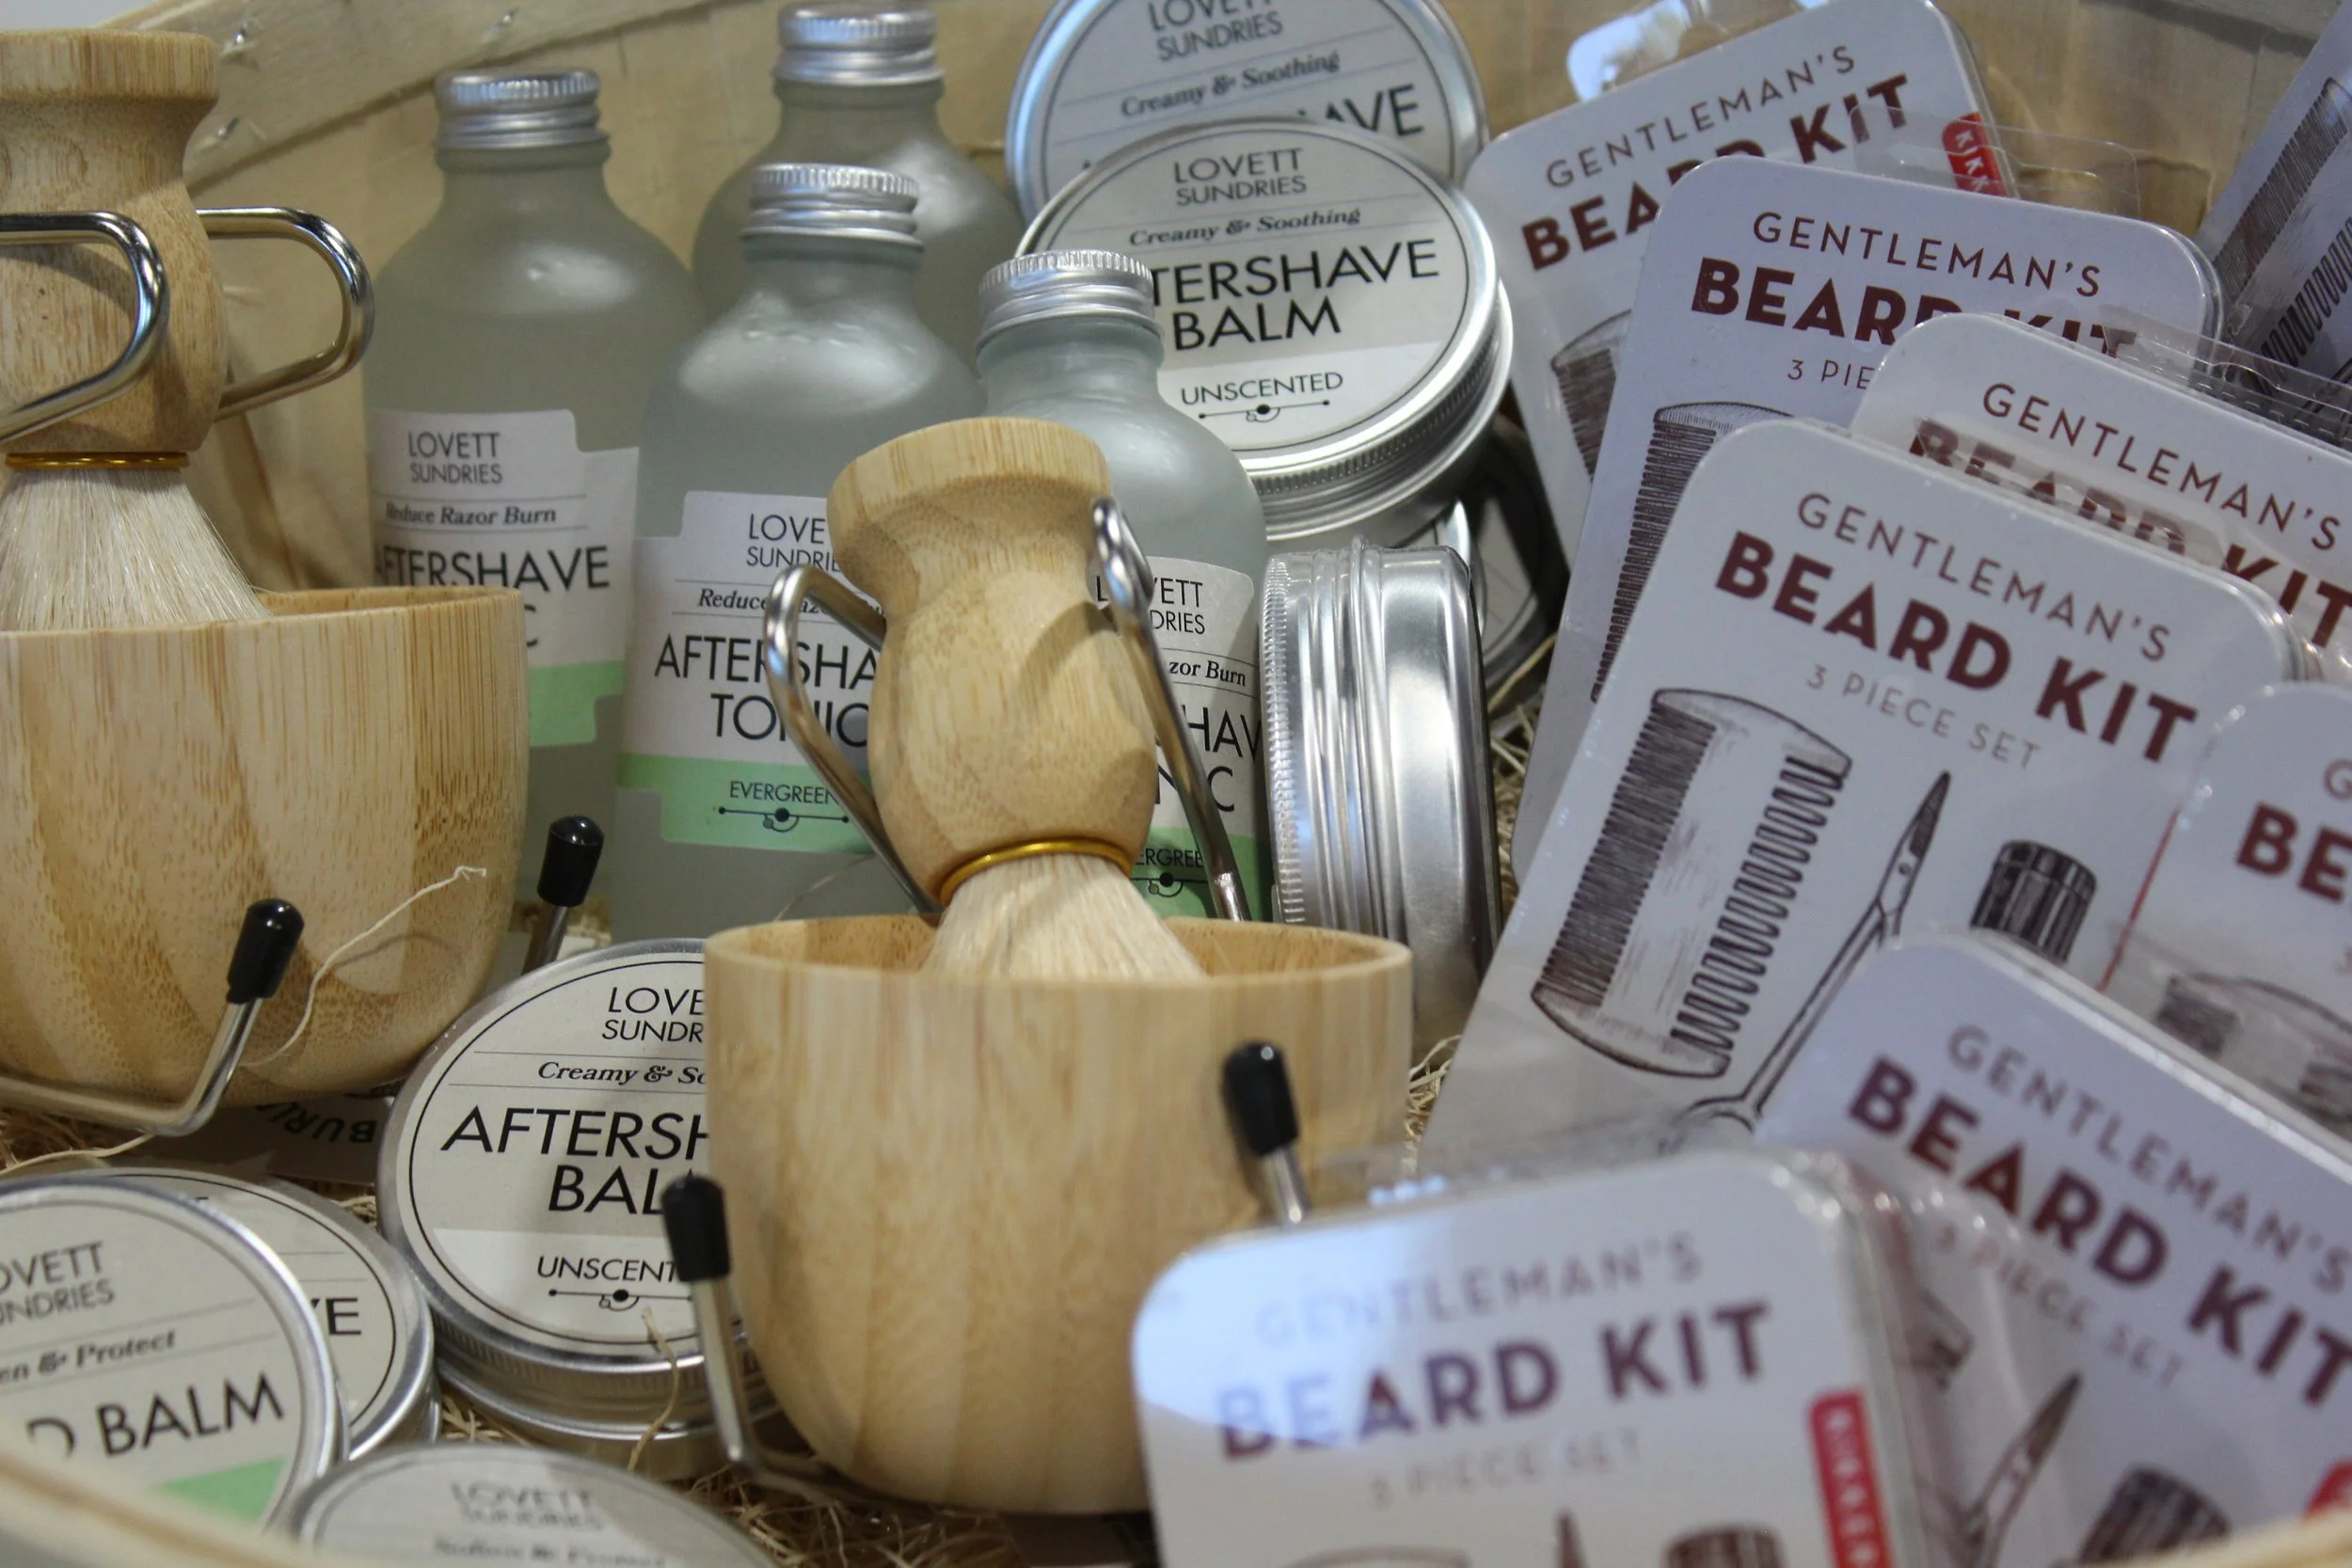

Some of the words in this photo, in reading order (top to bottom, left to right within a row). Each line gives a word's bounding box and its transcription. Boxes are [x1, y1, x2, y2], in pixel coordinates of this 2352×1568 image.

[1156, 11, 1284, 62] SUNDRIES
[1120, 85, 1207, 119] Creamy
[1211, 74, 1237, 96] &
[1241, 50, 1341, 89] Soothing
[1546, 45, 1856, 189] GENTLEMAN'S
[1789, 72, 1909, 164] KIT
[1174, 148, 1304, 183] LOVETT
[1175, 175, 1308, 206] SUNDRIES
[1128, 229, 1221, 246] Creamy
[1225, 219, 1250, 234] &
[1257, 208, 1361, 234] Soothing
[1152, 238, 1439, 307] TERSHAVE
[1753, 212, 2101, 297] GENTLEMAN'S
[1172, 294, 1343, 351] BALM
[1181, 371, 1343, 405] UNSCENTED
[1788, 359, 1804, 381] 3
[1821, 360, 1875, 390] PIE
[407, 432, 501, 459] LOVETT
[1982, 382, 2342, 551] GENTLEMAN'S
[409, 463, 503, 485] SUNDRIES
[439, 505, 500, 526] Razor
[503, 505, 557, 525] Burn
[749, 513, 826, 545] LOVE
[1797, 492, 2171, 661] GENTLEMAN'S
[1149, 610, 1205, 635] DRIES
[1715, 530, 2012, 690] BEARD
[2035, 655, 2199, 765] KIT
[1168, 660, 1200, 677] zor
[1205, 659, 1246, 687] Burn
[1805, 664, 1826, 690] 3
[1843, 672, 1956, 738] PIECE
[1968, 722, 2041, 770] SET
[608, 987, 705, 1016] LOVE
[601, 1019, 704, 1043] SUNDR
[537, 1061, 640, 1085] Creamy
[643, 1065, 673, 1084] &
[439, 1104, 709, 1160] AFTERSH
[1947, 1024, 2352, 1294] GENTLEMAN'S
[548, 1164, 694, 1215] BAL
[1847, 1055, 2170, 1289] BEARD
[2186, 1263, 2352, 1407] KIT
[536, 1256, 675, 1282] UNSCENT
[1255, 1229, 1703, 1348] GENTLEMAN'S
[76, 1330, 176, 1370] Protect
[1220, 1339, 1562, 1460] BEARD
[1601, 1300, 1771, 1400] KIT
[95, 1370, 285, 1459] BALM
